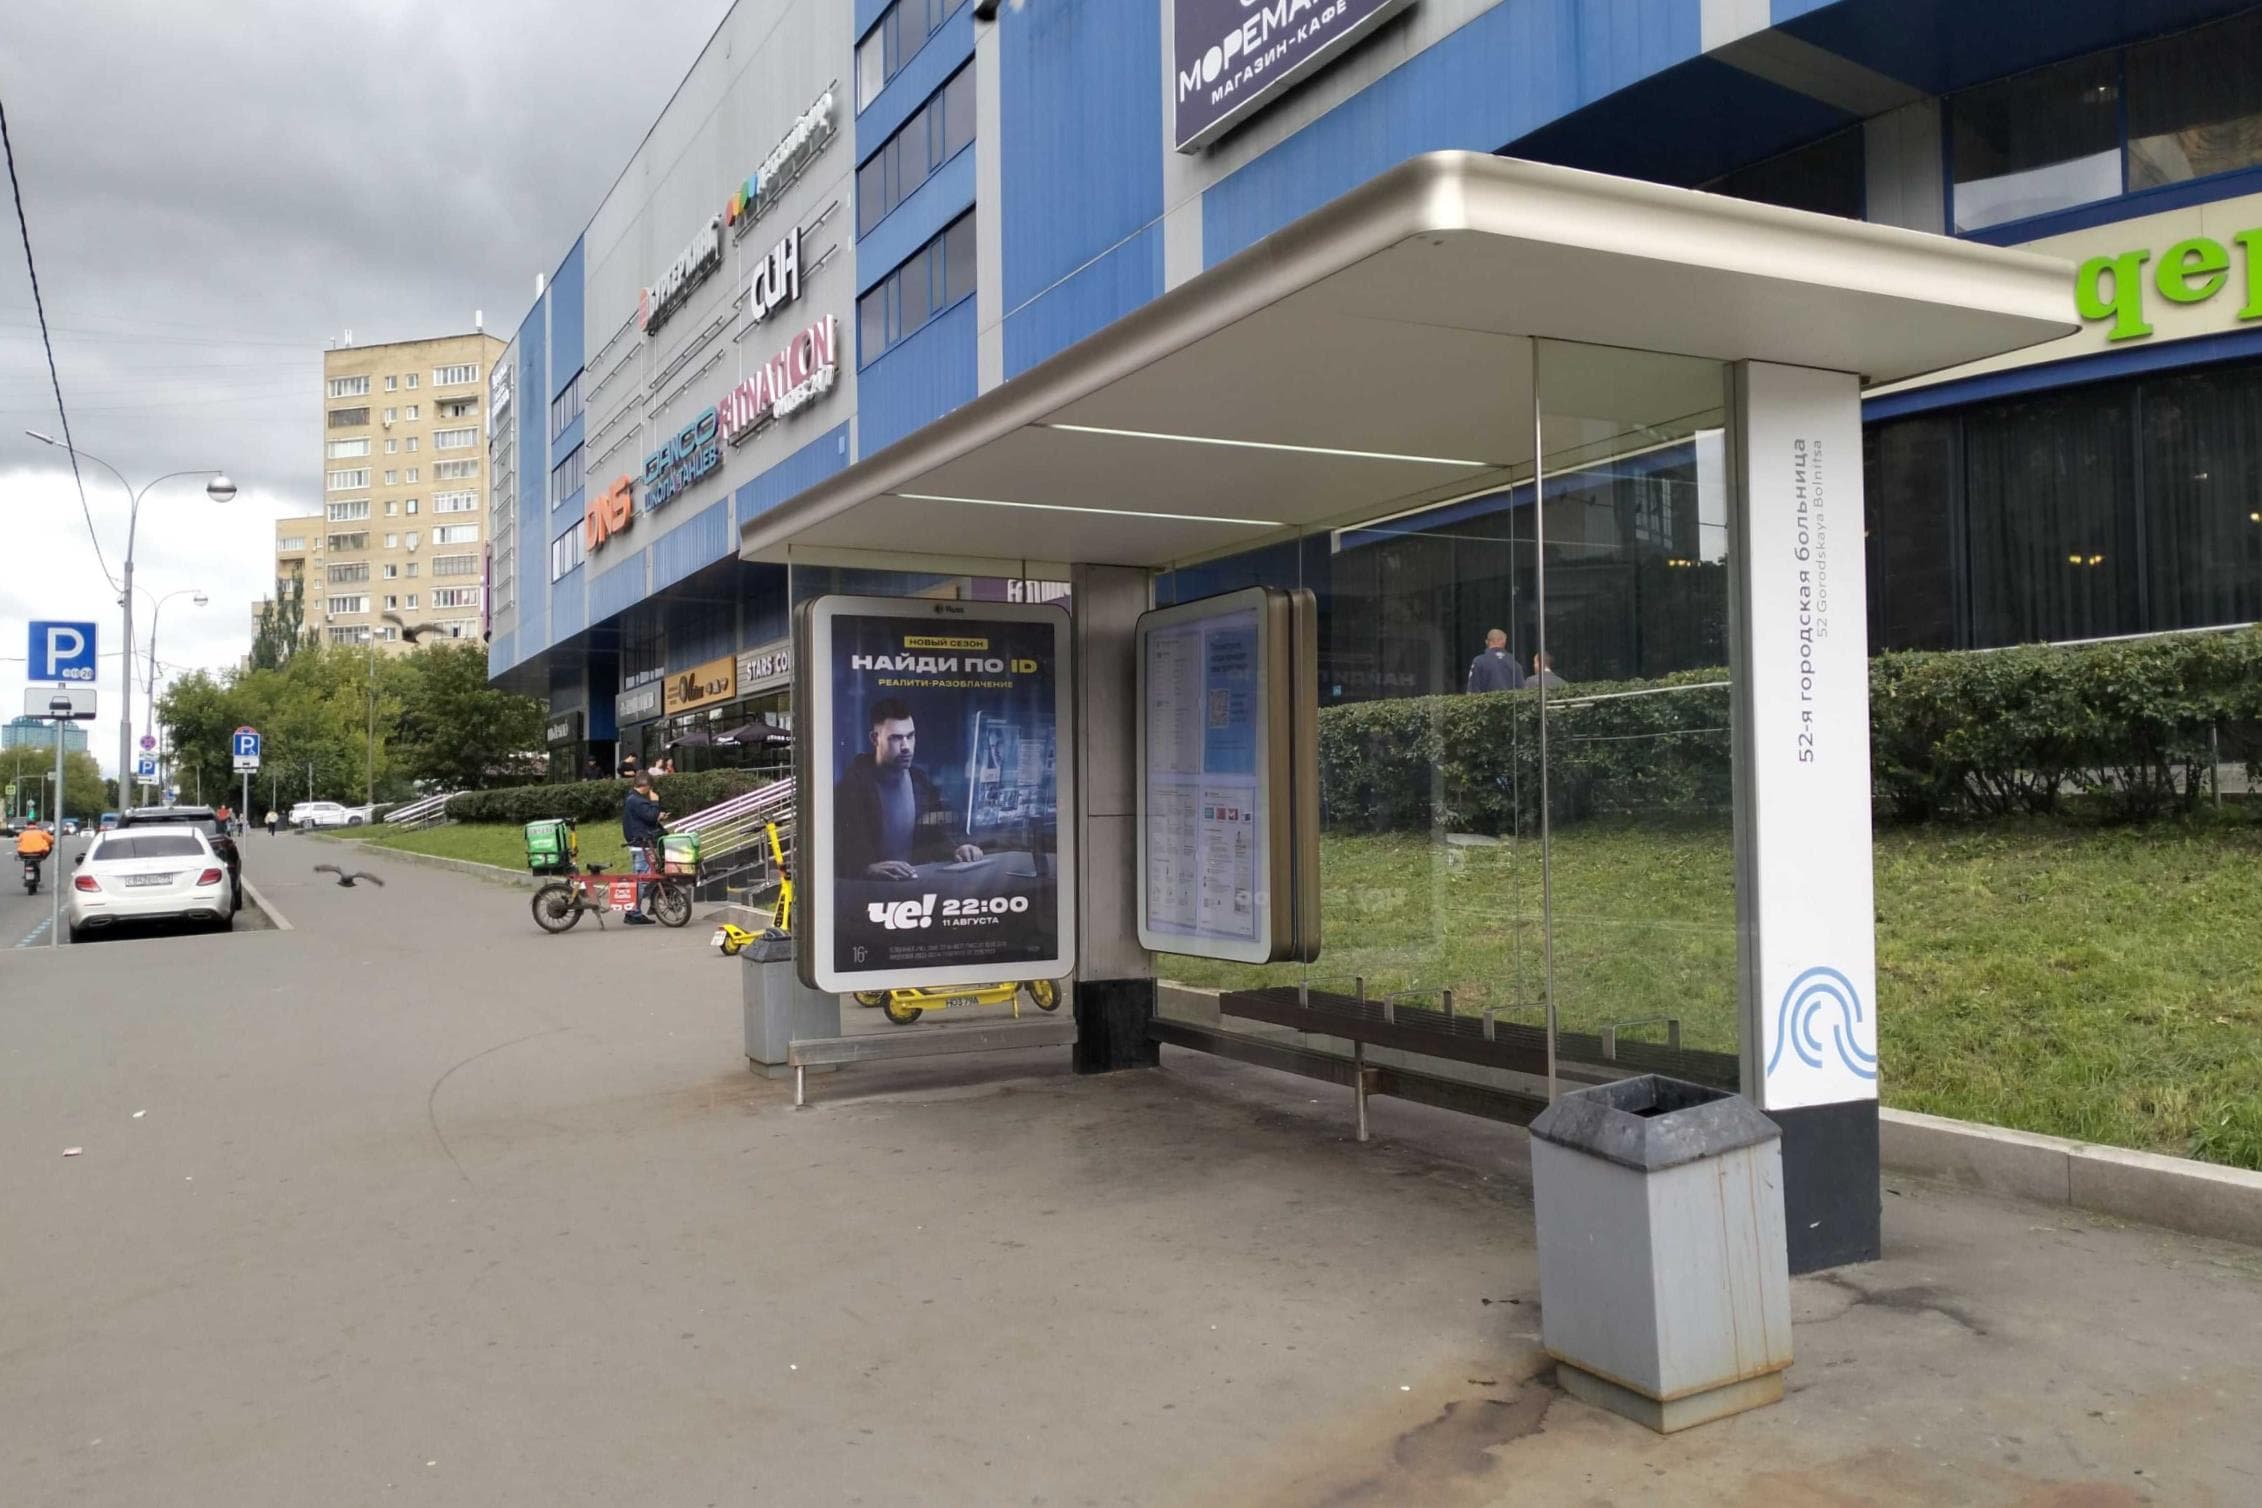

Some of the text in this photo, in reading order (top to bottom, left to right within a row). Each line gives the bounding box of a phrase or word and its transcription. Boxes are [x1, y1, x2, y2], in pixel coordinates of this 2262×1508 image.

[1179, 0, 1320, 103] МОРЕМА
[1211, 1, 1347, 105] МАГАЗИН-КАФЕ
[719, 313, 834, 440] FITNATION
[644, 443, 717, 513] ШКОЛА ТАНЦЕВ
[586, 473, 632, 552] DNS
[1812, 440, 1828, 638] 52 Gorodskaya Bolnitsa
[1794, 438, 1815, 763] 52-я городская больница
[47, 627, 85, 675] P
[747, 652, 789, 681] STARS CO
[851, 652, 1038, 674] НАЙДИ ПО ID
[909, 637, 984, 648] НОВЫЙ СЕЗОН
[878, 678, 1014, 689] РЕАЛИТИ-РАЗОБЛАЧЕНИЕ
[942, 896, 1029, 916] 22:00
[942, 916, 999, 927] 11 АВГУСТА
